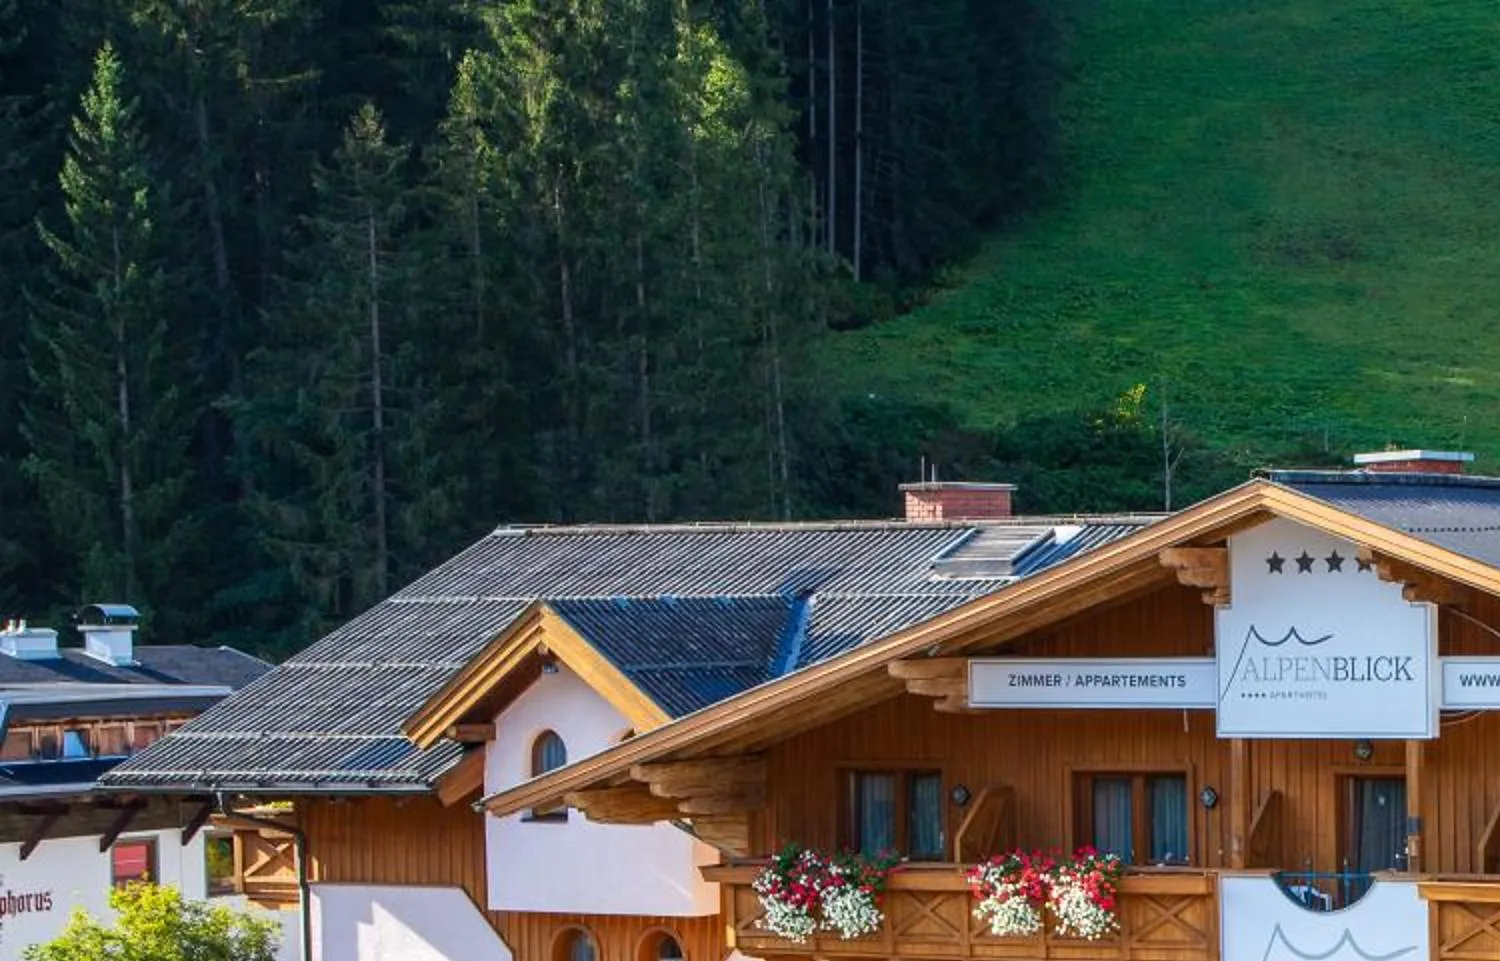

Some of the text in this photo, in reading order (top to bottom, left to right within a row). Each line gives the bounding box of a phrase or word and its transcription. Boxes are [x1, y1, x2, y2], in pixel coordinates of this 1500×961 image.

[1240, 655, 1414, 682] ALPENBLICK
[1008, 673, 1062, 687] ZIMMER
[1075, 674, 1187, 688] APPARTEMENTS
